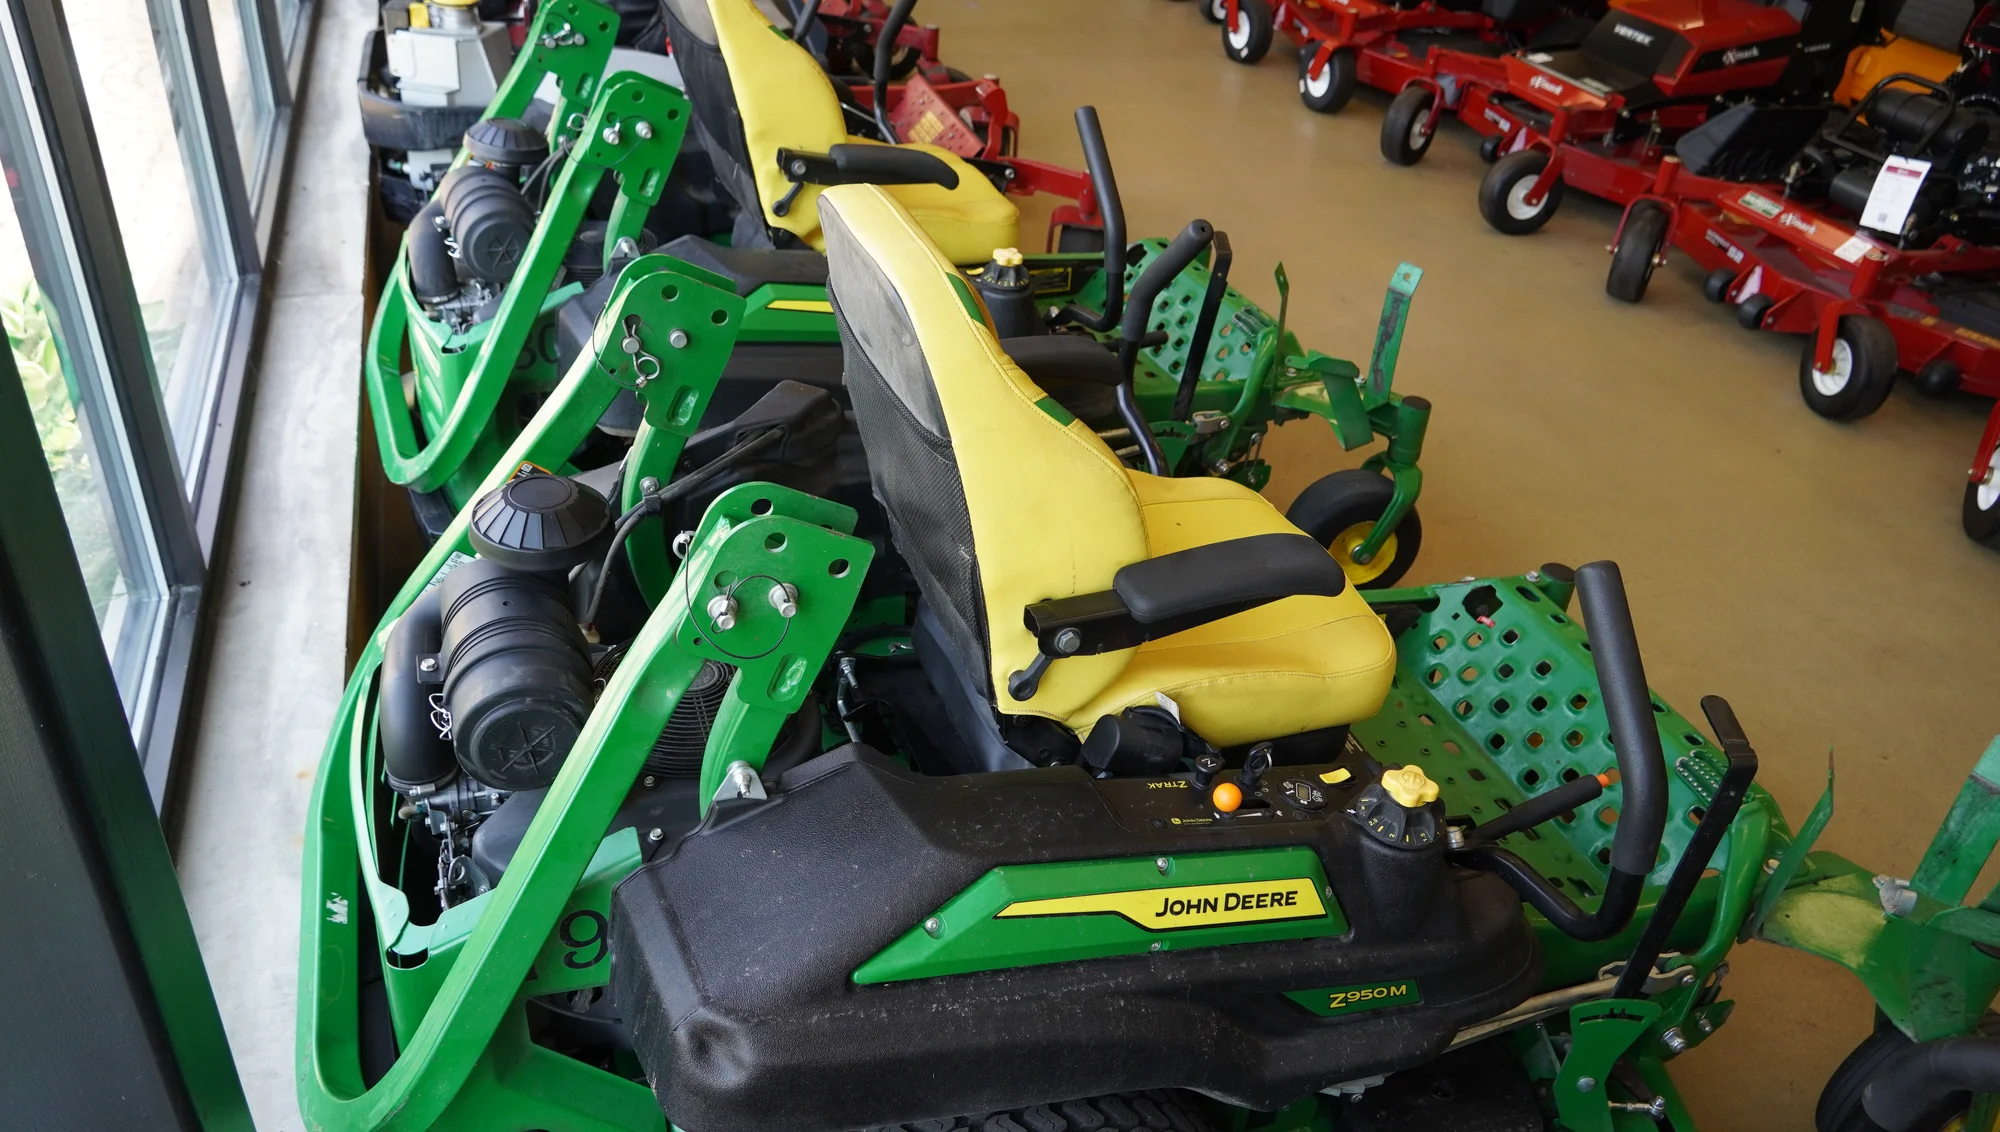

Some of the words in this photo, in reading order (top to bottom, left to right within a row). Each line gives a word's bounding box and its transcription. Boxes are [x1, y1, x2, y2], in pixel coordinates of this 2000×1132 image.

[1148, 780, 1188, 789] ZTRAK
[1155, 896, 1219, 918] JOHN
[1223, 890, 1299, 912] DEERE
[1329, 984, 1408, 1009] Z950M
